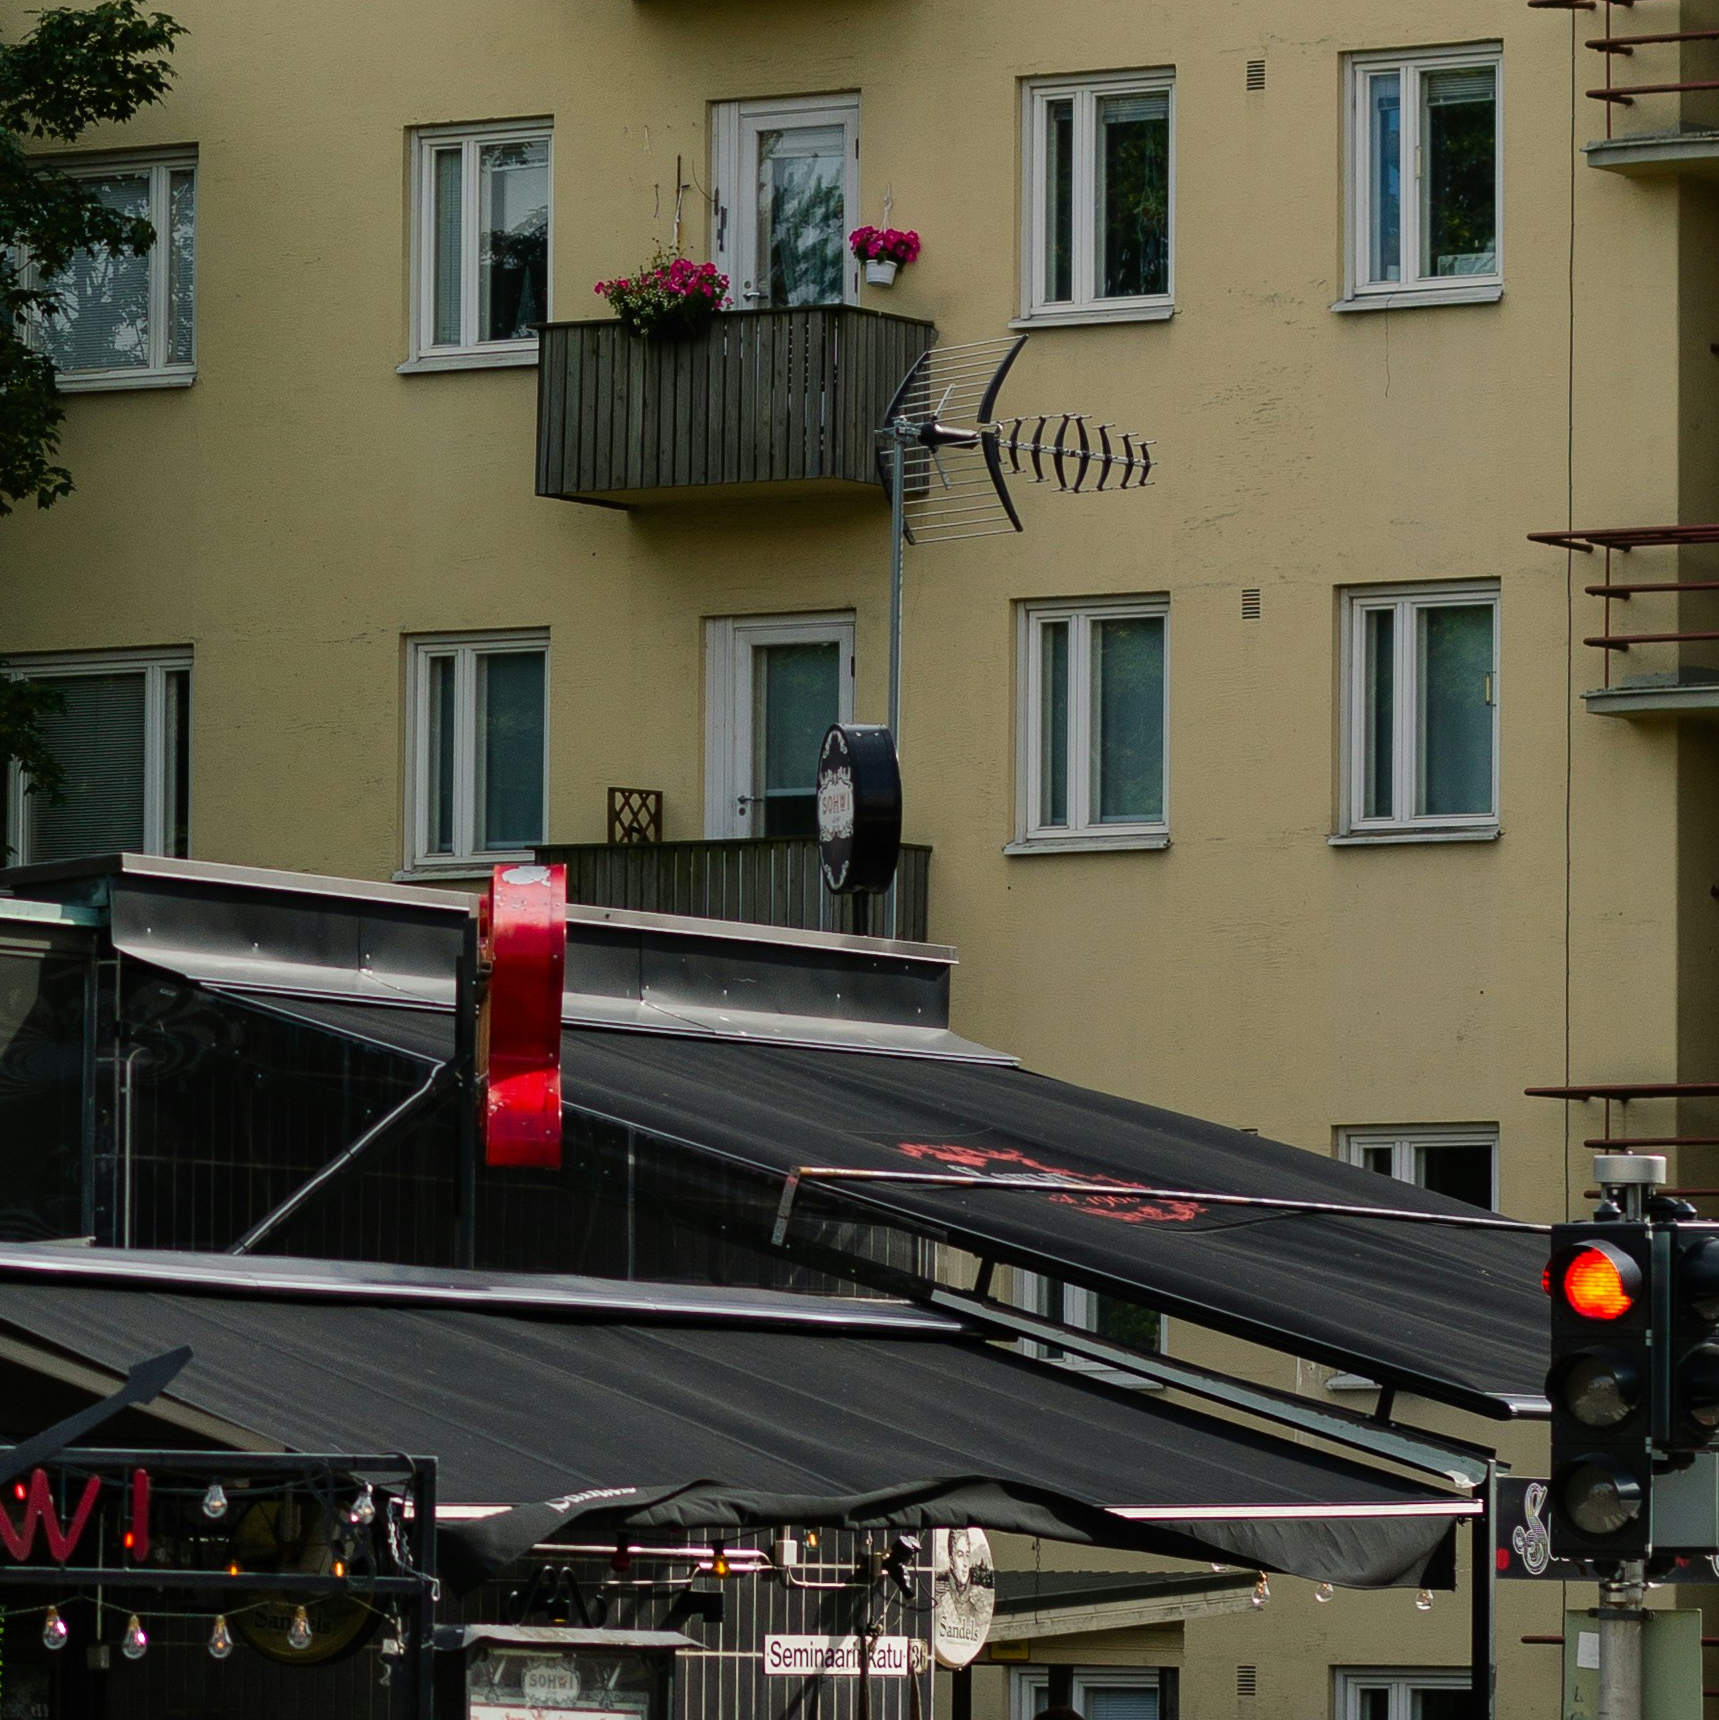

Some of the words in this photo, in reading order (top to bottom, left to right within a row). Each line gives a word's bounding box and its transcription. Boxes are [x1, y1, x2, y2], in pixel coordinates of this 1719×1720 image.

[822, 792, 850, 816] SOHWI
[254, 1607, 332, 1635] Sanels
[938, 1616, 979, 1642] Sandels
[770, 1640, 903, 1669] Seminaarikatu
[911, 1644, 927, 1669] 36
